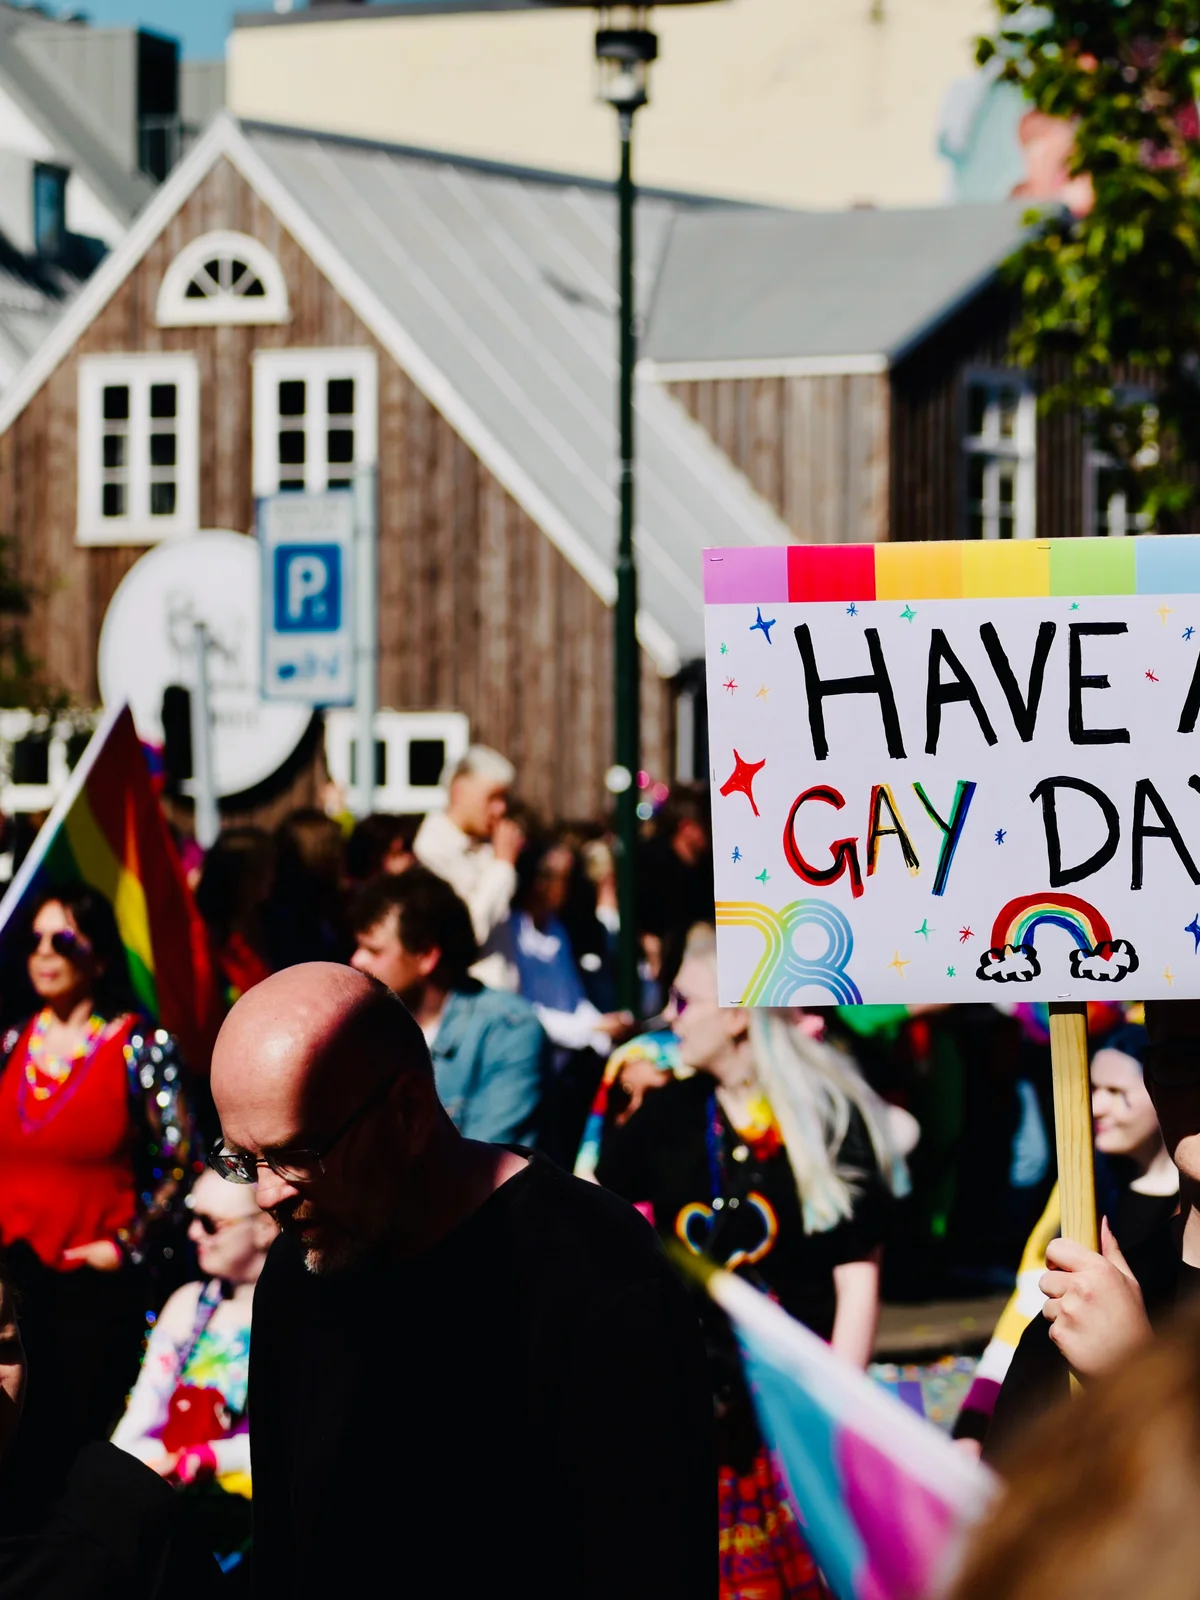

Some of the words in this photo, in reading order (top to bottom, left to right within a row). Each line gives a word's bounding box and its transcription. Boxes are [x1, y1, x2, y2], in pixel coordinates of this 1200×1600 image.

[288, 554, 328, 620] P
[793, 621, 1131, 761] HAVE
[782, 779, 977, 899] GAY
